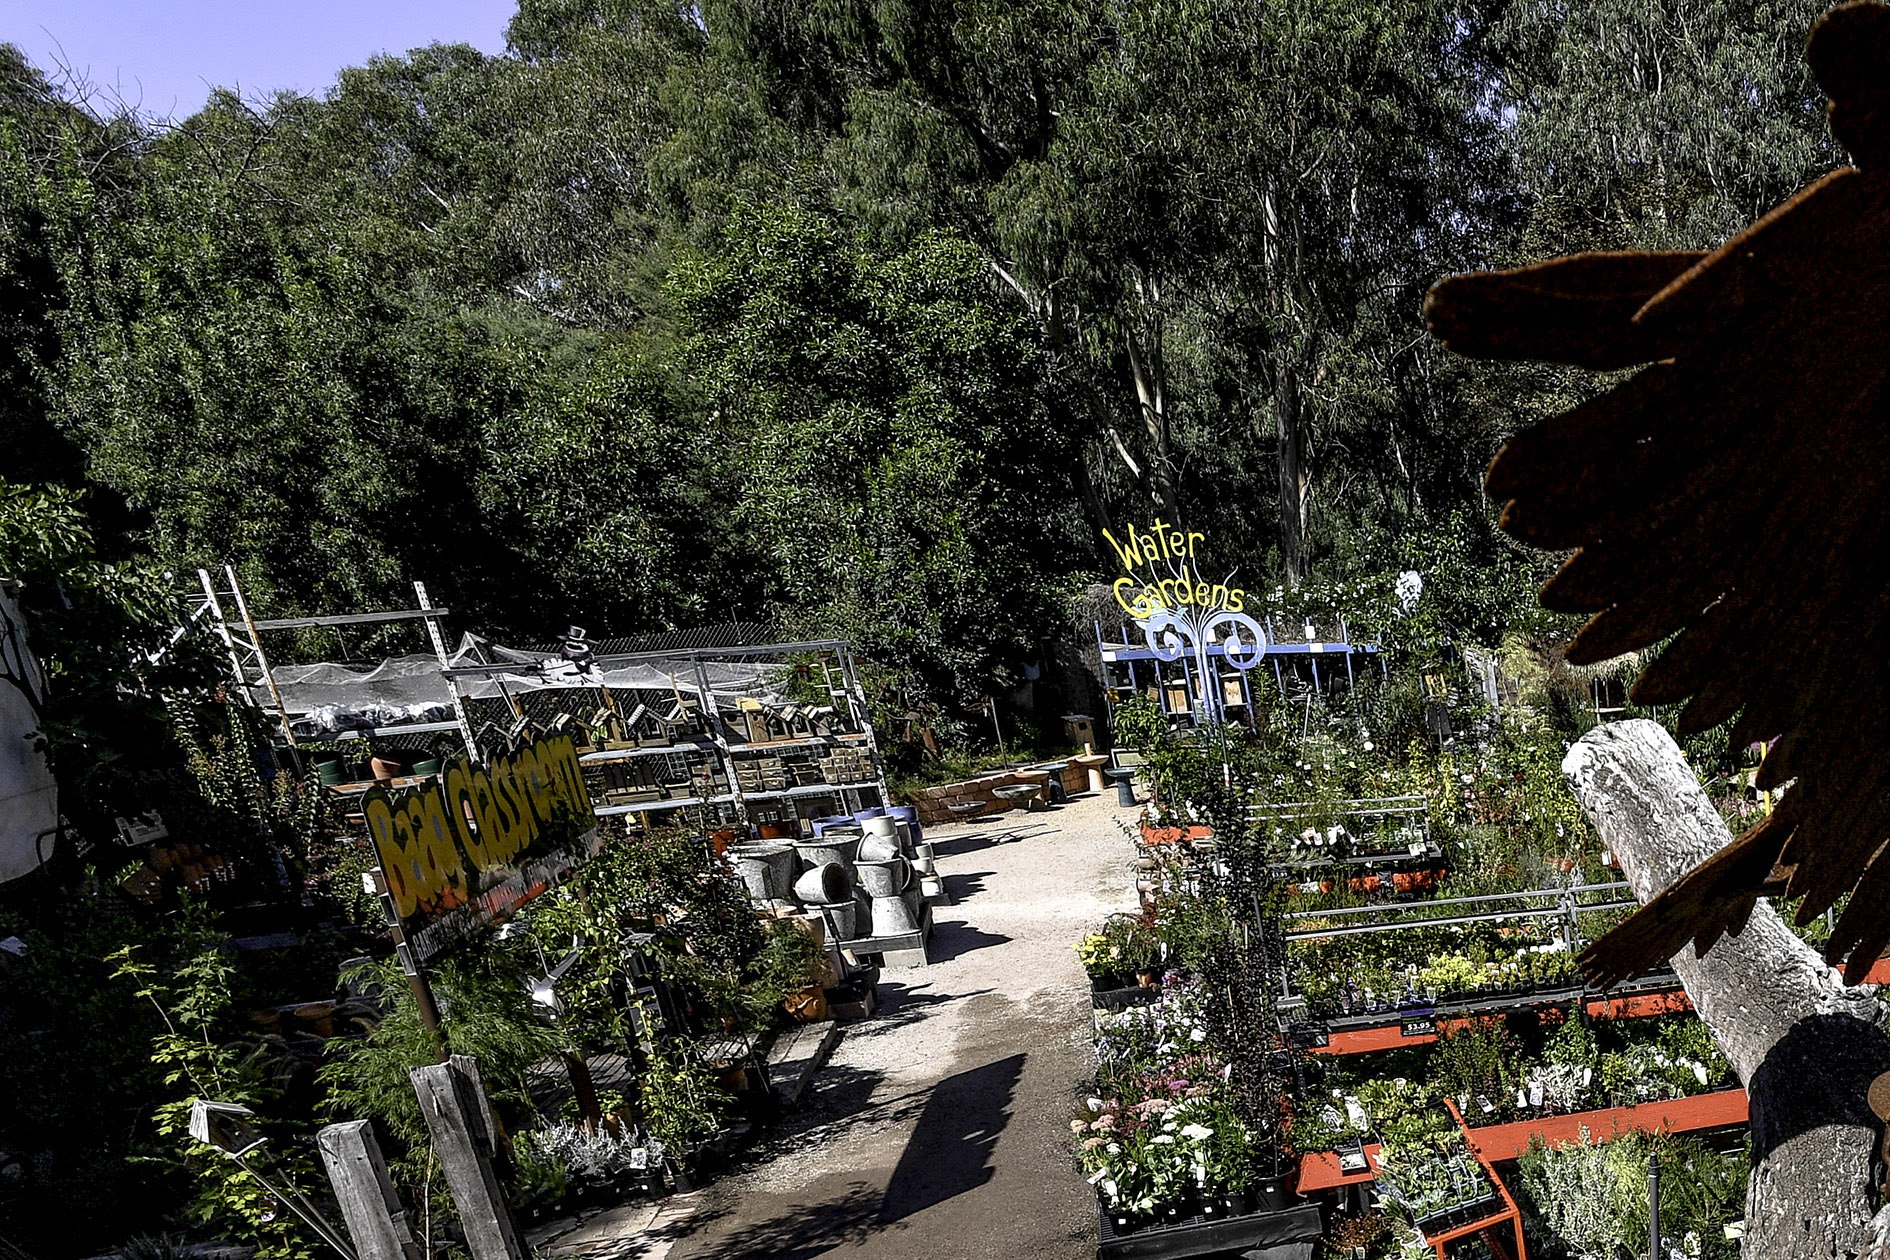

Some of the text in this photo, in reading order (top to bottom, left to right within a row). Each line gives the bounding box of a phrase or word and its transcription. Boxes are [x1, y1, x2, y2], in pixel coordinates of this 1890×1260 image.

[1102, 517, 1205, 571] Water
[1113, 565, 1245, 619] Gardens
[367, 785, 469, 918] Baag
